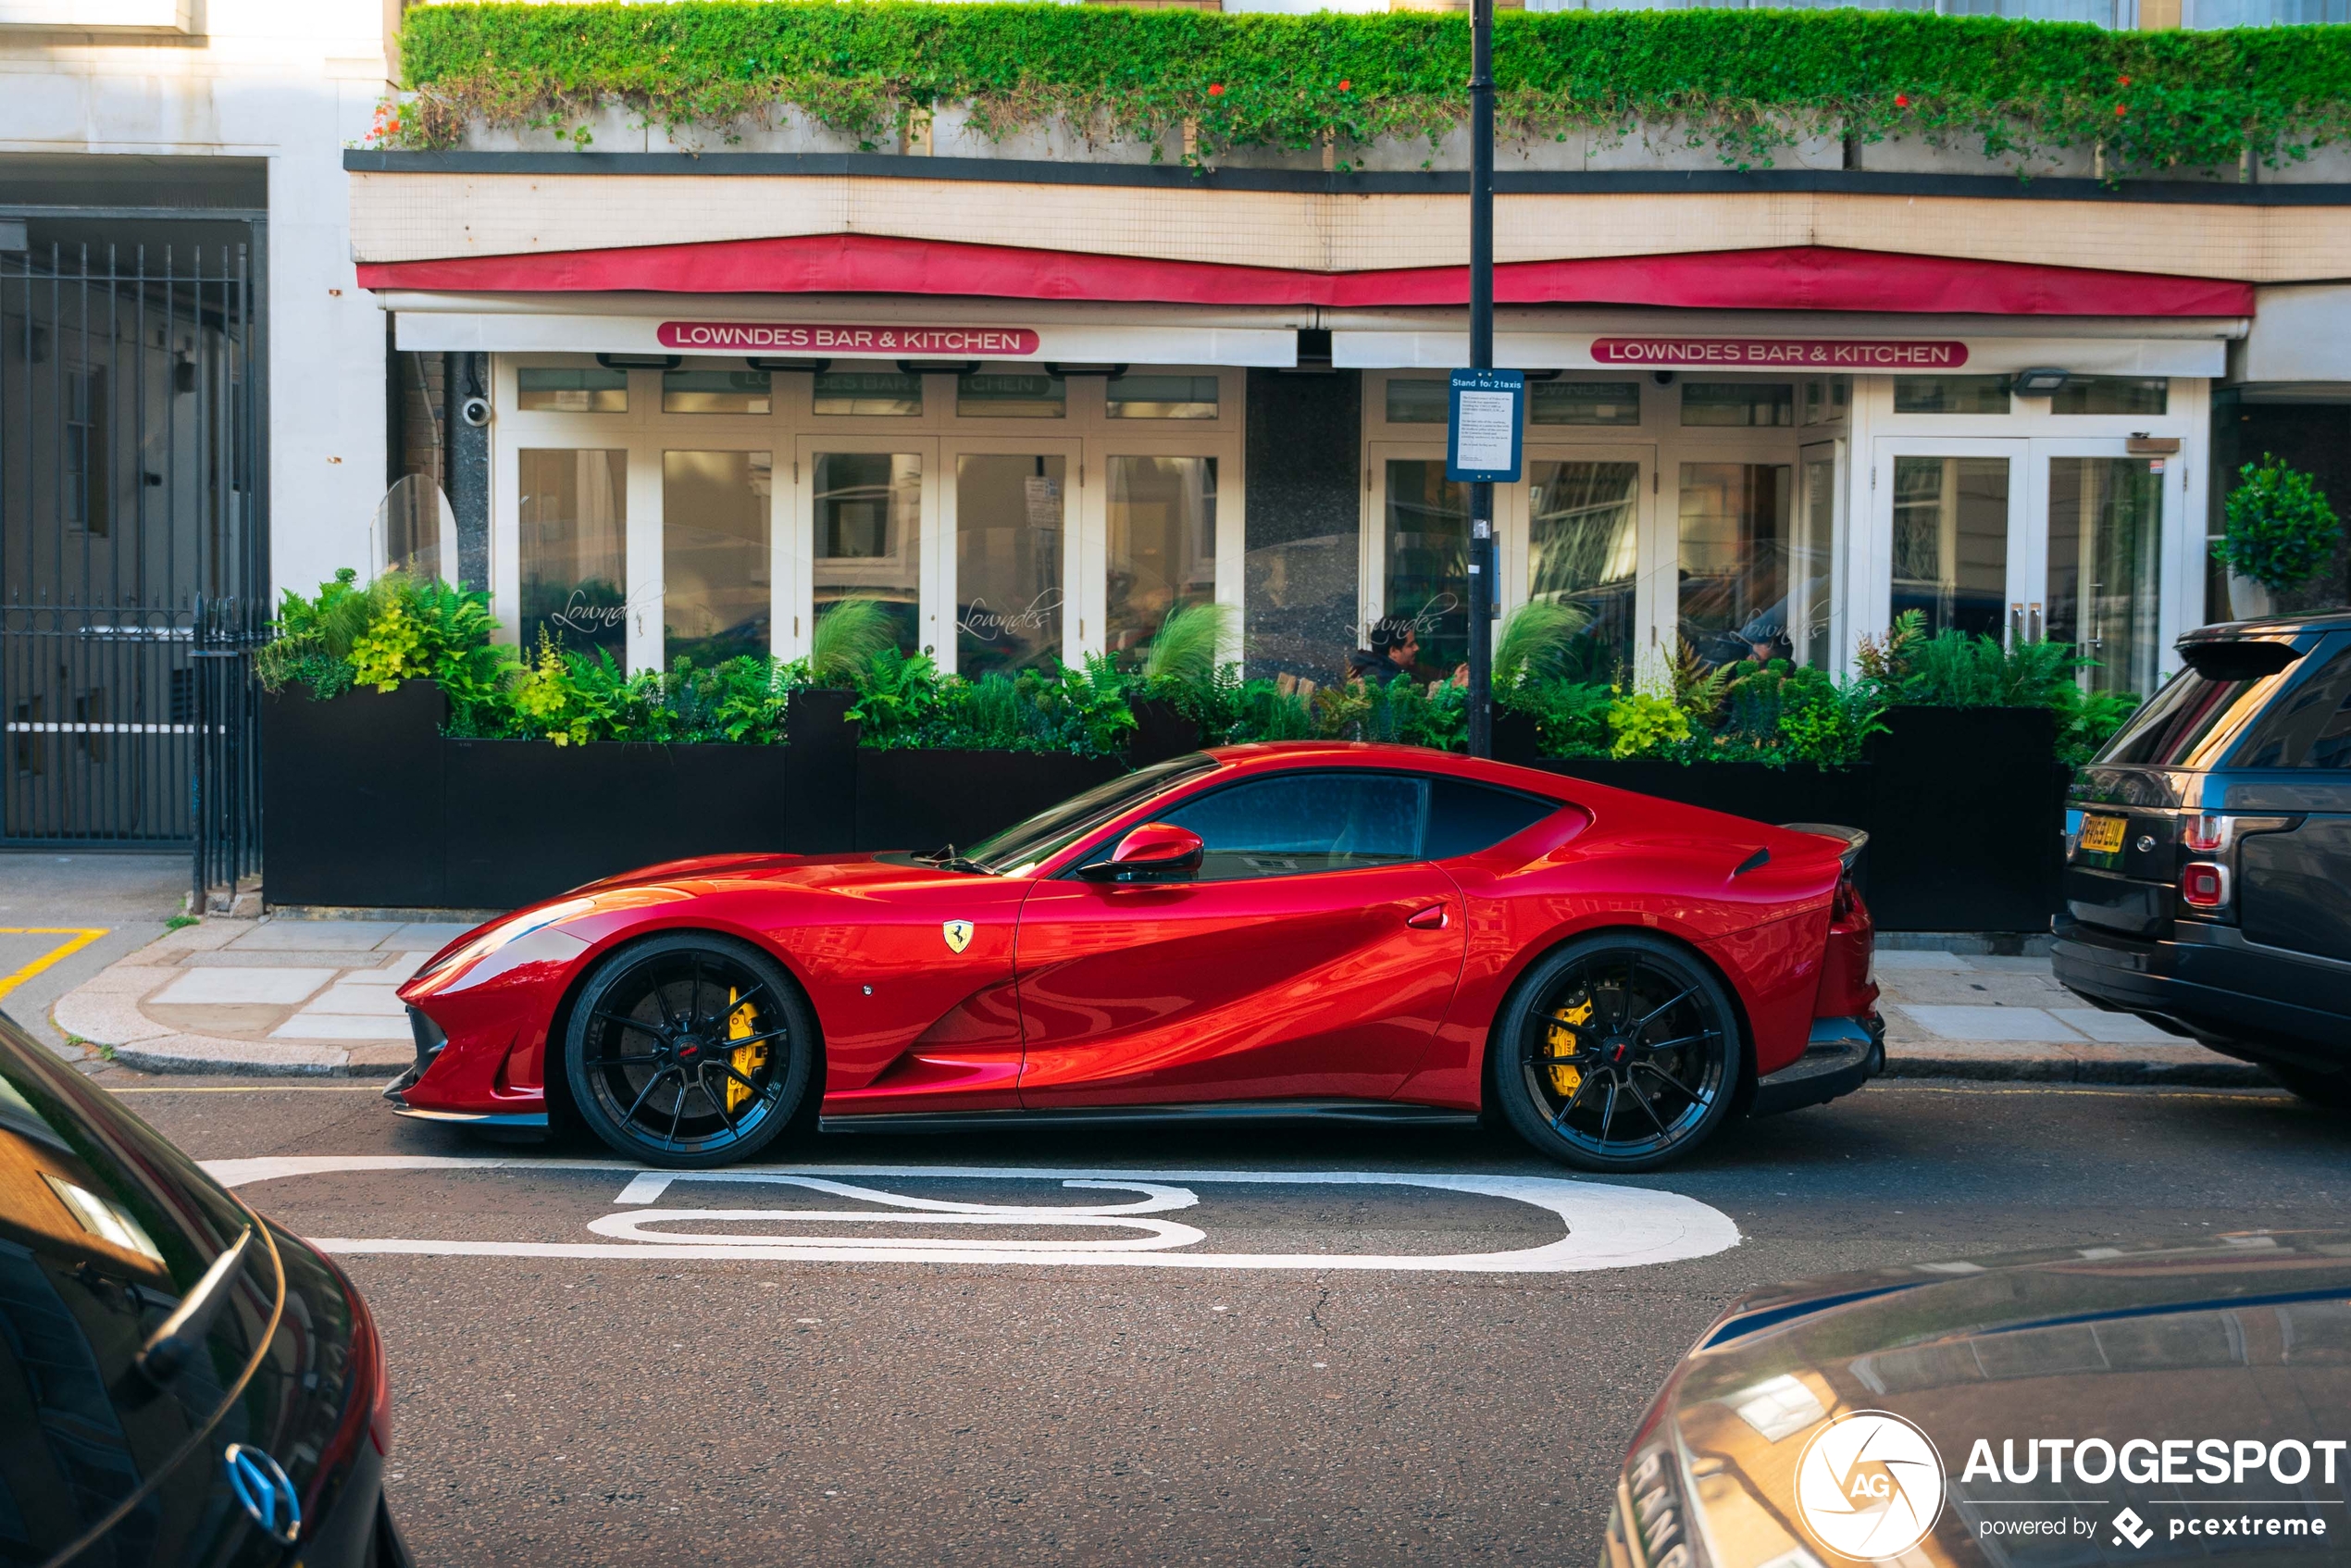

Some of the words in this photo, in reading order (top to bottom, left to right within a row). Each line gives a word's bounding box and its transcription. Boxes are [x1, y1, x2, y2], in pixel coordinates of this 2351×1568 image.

[676, 327, 809, 345] LOWNDES
[815, 330, 873, 347] BAR
[879, 331, 897, 347] &
[903, 331, 1020, 349] KITCHEN
[1609, 343, 1741, 360] LOWNDES
[1748, 345, 1803, 361] BAR
[1810, 345, 1827, 361] &
[1834, 346, 1950, 363] KITCHEN
[1452, 379, 1476, 387] Stand
[1479, 380, 1492, 388] for
[1493, 380, 1499, 389] 2
[1500, 380, 1522, 389] taxis
[952, 587, 1065, 641] Lowndes
[1344, 592, 1459, 645] Lowndes
